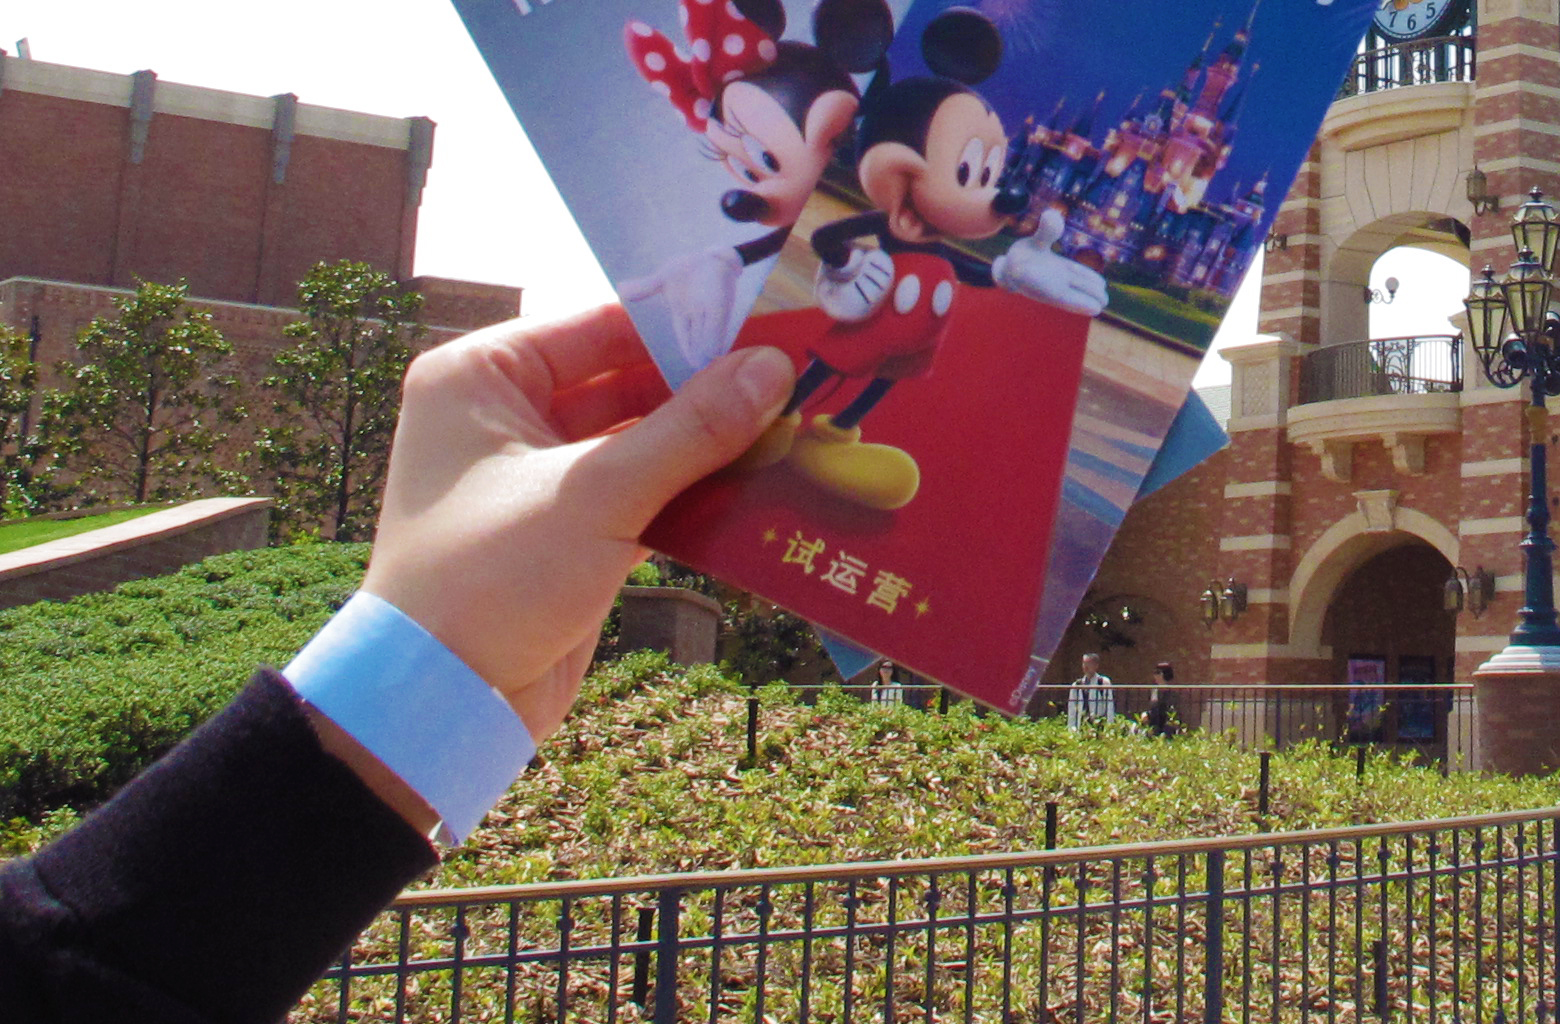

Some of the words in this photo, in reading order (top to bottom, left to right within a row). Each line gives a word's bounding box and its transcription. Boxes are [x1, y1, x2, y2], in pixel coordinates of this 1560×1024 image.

[1426, 2, 1436, 19] 5
[1389, 11, 1398, 28] 7
[1407, 14, 1416, 30] 6
[781, 531, 913, 614] 试运营
